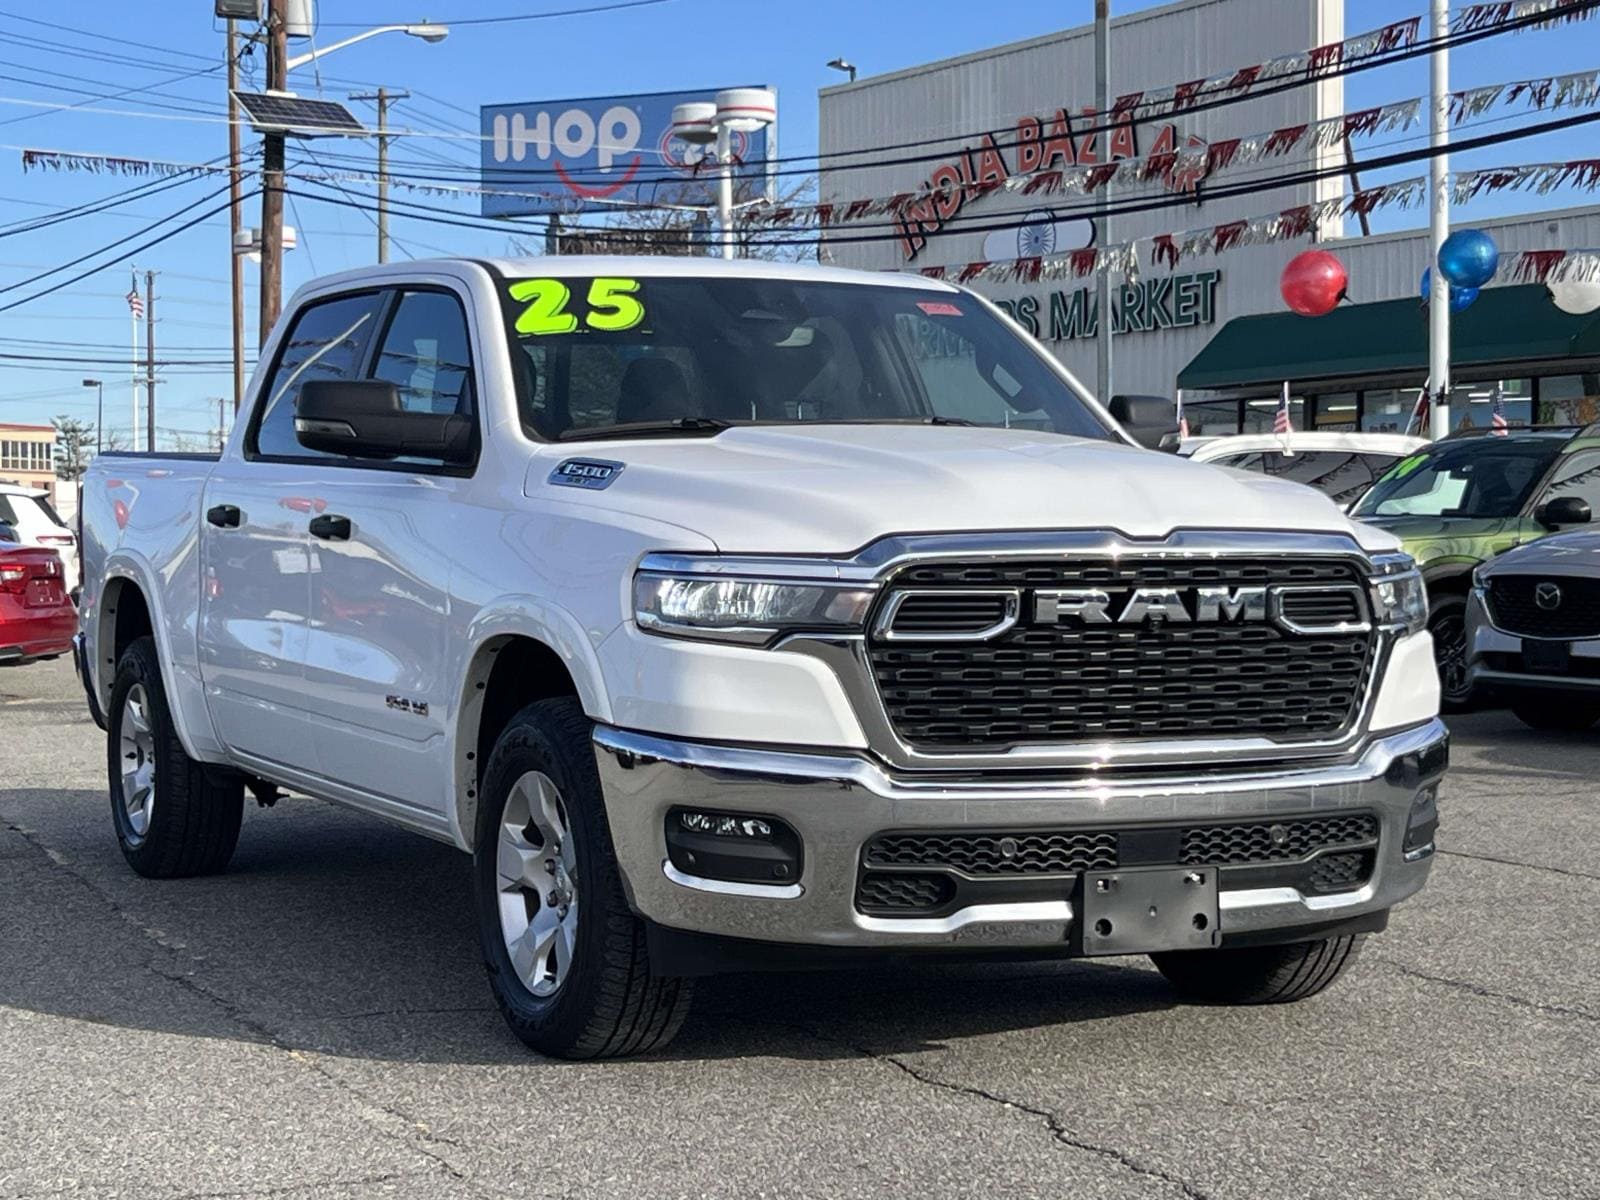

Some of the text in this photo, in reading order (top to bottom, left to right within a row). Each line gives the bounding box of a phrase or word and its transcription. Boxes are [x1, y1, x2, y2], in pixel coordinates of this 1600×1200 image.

[494, 106, 641, 174] IHOP
[892, 133, 1009, 262] INDIA
[509, 278, 645, 335] 25
[562, 463, 612, 478] 1500
[1034, 587, 1266, 623] RAM
